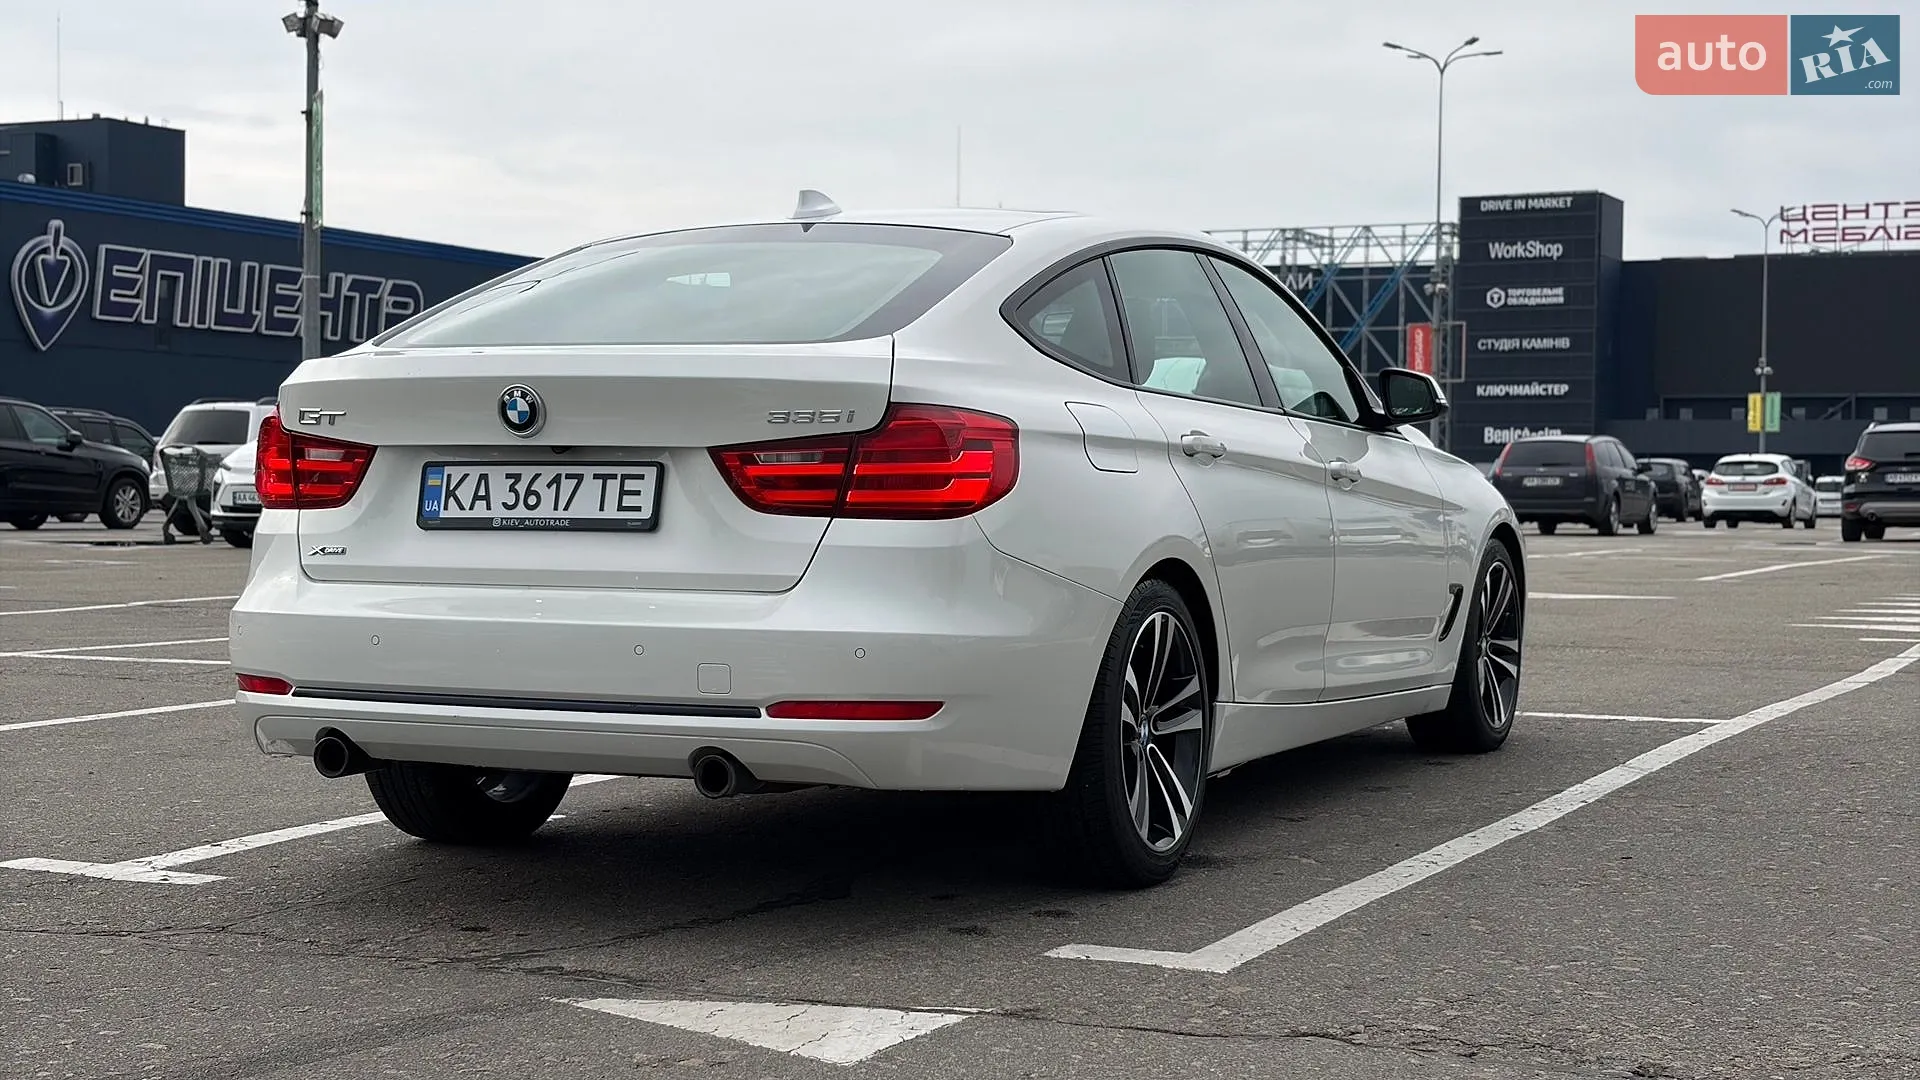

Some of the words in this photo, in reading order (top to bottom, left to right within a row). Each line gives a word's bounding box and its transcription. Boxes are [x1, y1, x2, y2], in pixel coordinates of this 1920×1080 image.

[1480, 198, 1512, 212] DRIVE
[1514, 198, 1526, 210] IN
[1528, 197, 1573, 209] MARKET
[1488, 240, 1563, 261] WorkShop
[1477, 338, 1520, 351] СТУДІЯ
[1522, 337, 1570, 350] КАМІНІВ
[503, 390, 534, 404] BMW
[1476, 382, 1569, 397] КЛЮЧМАЙСТЕР
[299, 407, 347, 425] GT
[767, 409, 856, 424] 335i
[443, 473, 492, 512] KA
[501, 473, 585, 512] 3617
[592, 473, 645, 513] TE
[425, 500, 439, 512] UA
